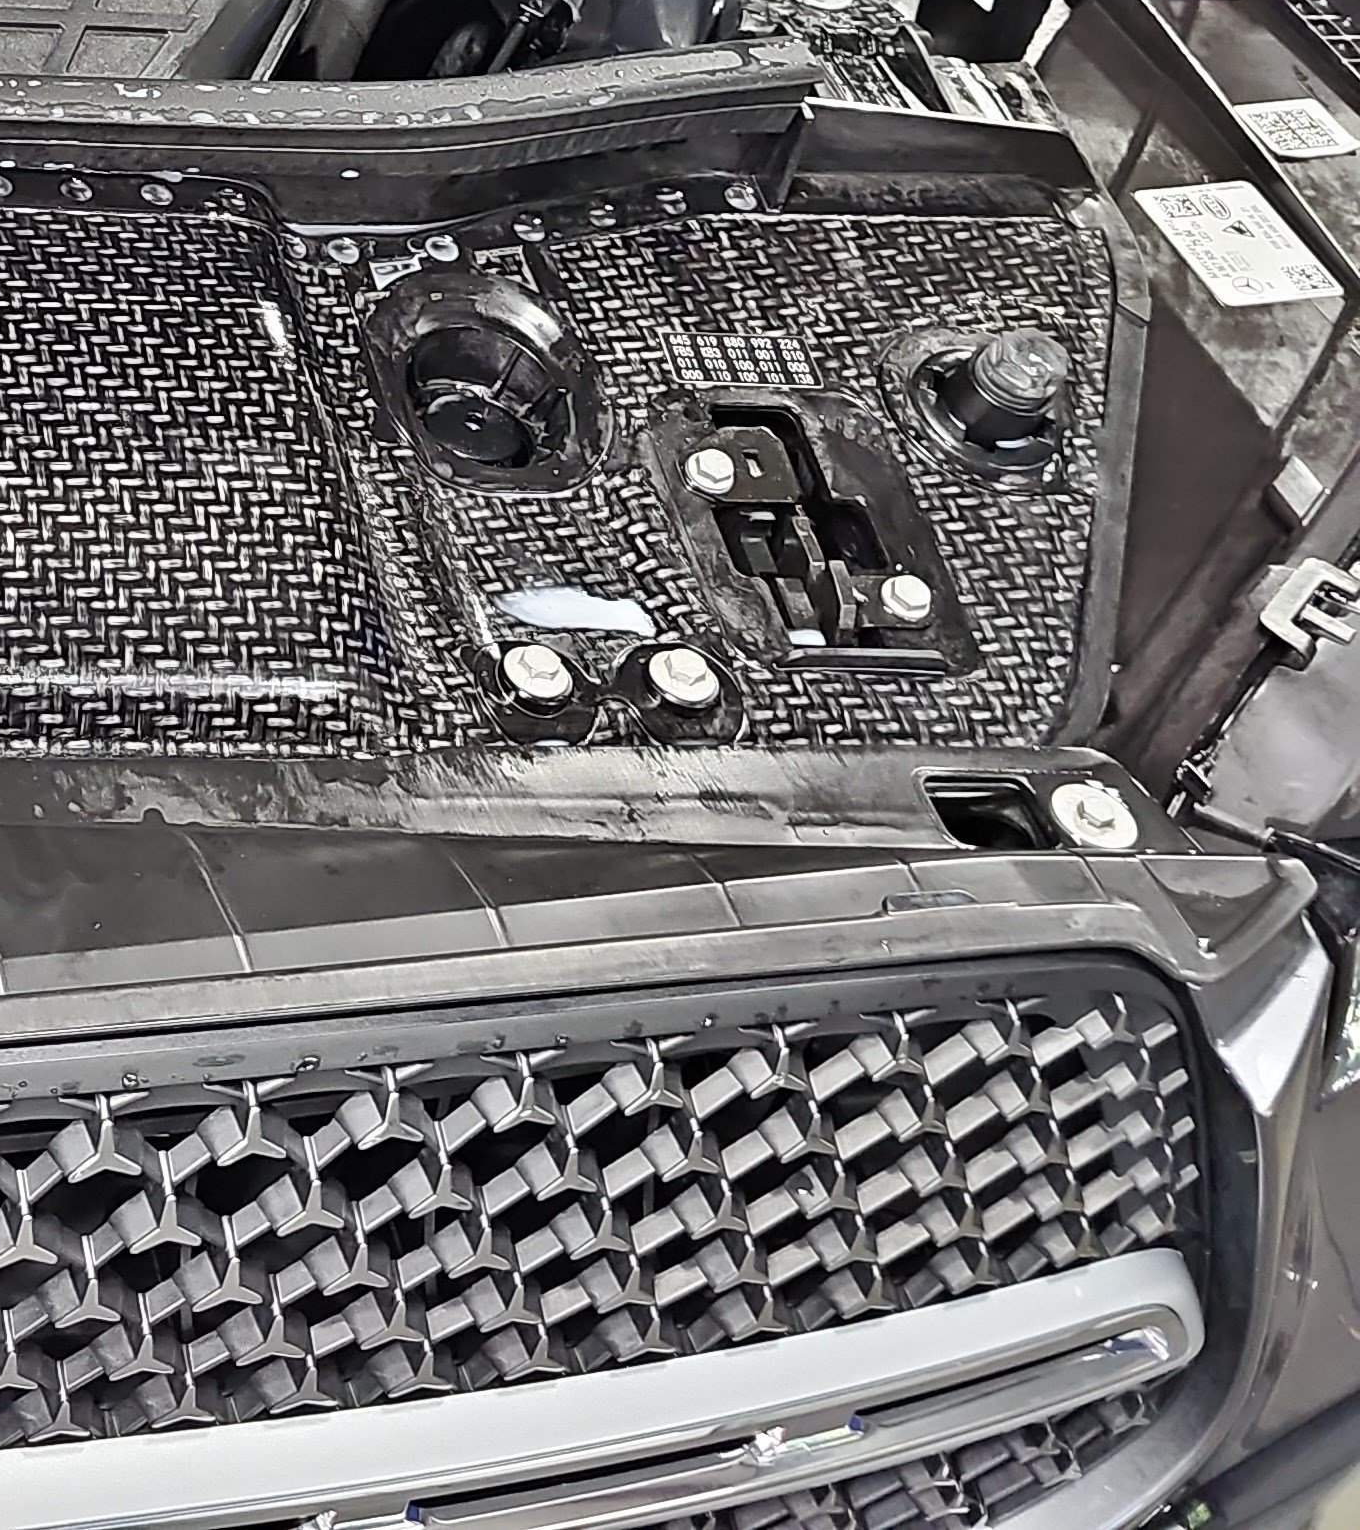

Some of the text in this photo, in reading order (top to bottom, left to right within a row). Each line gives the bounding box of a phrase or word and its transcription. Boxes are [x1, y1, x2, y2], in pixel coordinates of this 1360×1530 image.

[669, 335, 691, 346] 645
[697, 336, 717, 347] 619
[750, 338, 773, 349] 992
[778, 339, 801, 349] 224
[728, 349, 749, 359] 011
[755, 350, 776, 360] 001
[782, 351, 805, 361] 010
[677, 358, 810, 373] 011 010 100 011 000
[681, 370, 704, 380] 000
[710, 371, 731, 381] 110
[737, 372, 759, 382] 100
[765, 373, 785, 383] 101
